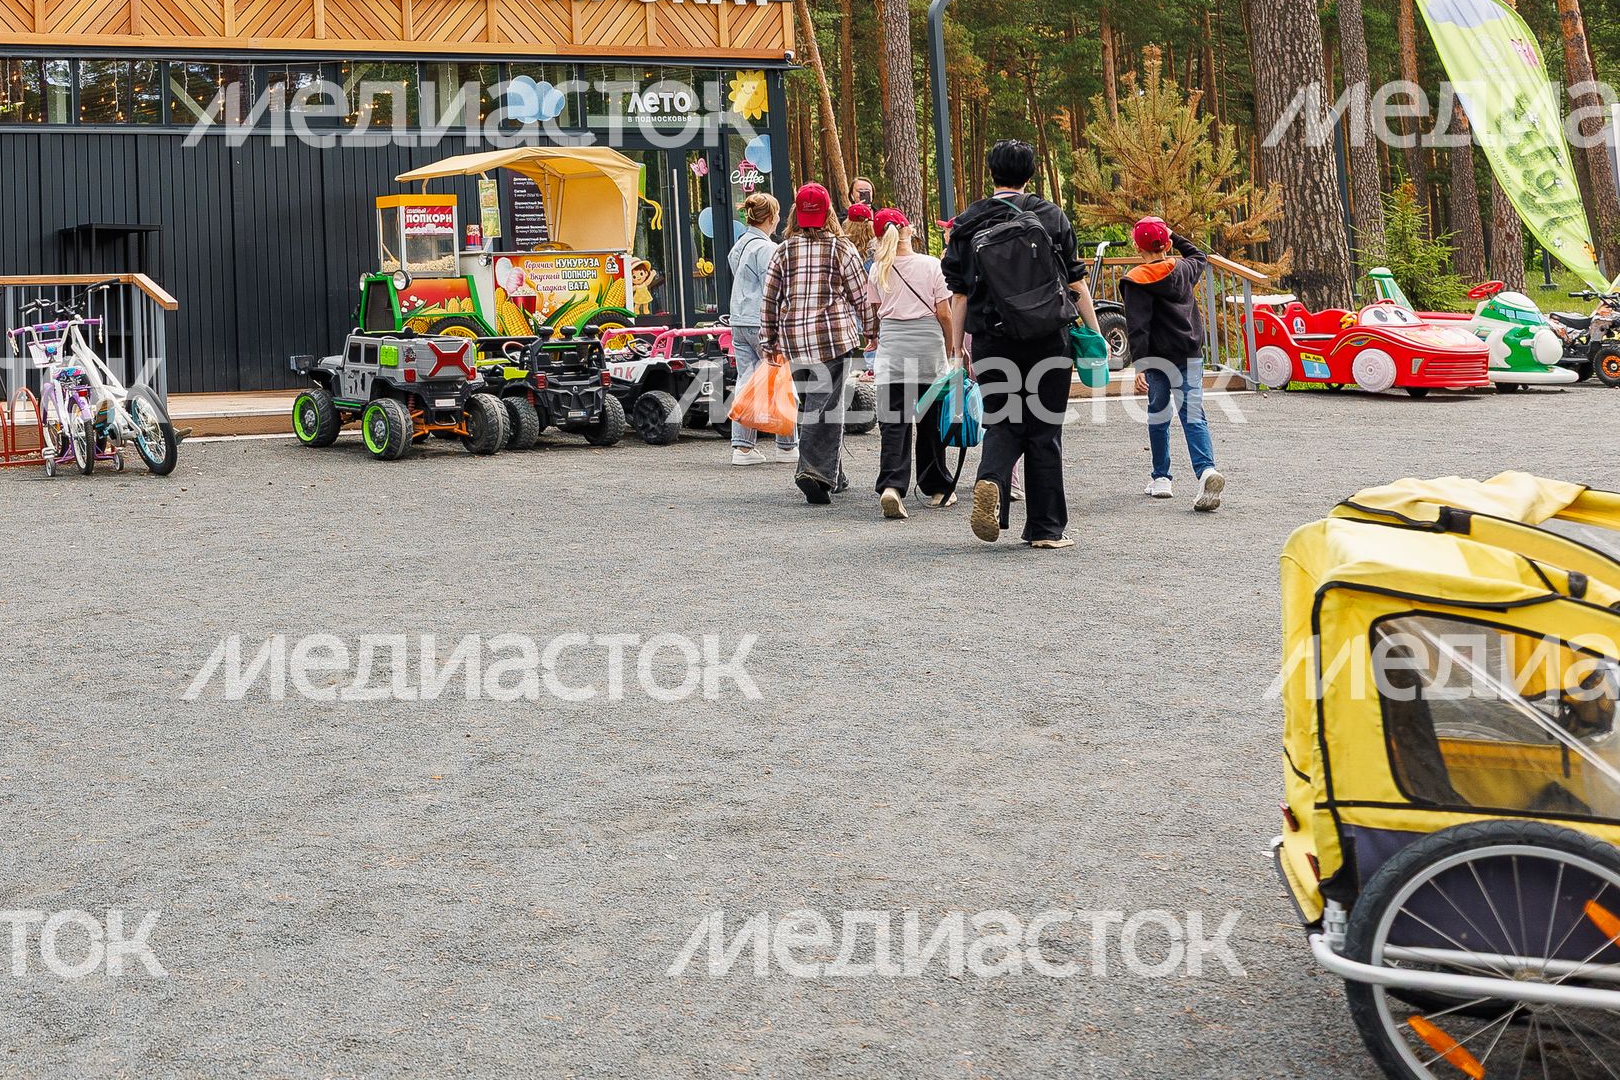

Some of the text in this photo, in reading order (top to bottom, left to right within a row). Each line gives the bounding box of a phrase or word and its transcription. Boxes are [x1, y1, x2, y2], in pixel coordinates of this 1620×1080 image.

[730, 169, 765, 188] Coffee
[405, 213, 453, 223] ПОПКОРН
[525, 257, 600, 269] Горячая КУКУРУЗА
[530, 270, 598, 282] Вкусный ПОПКОРН
[568, 281, 590, 291] ВАТА
